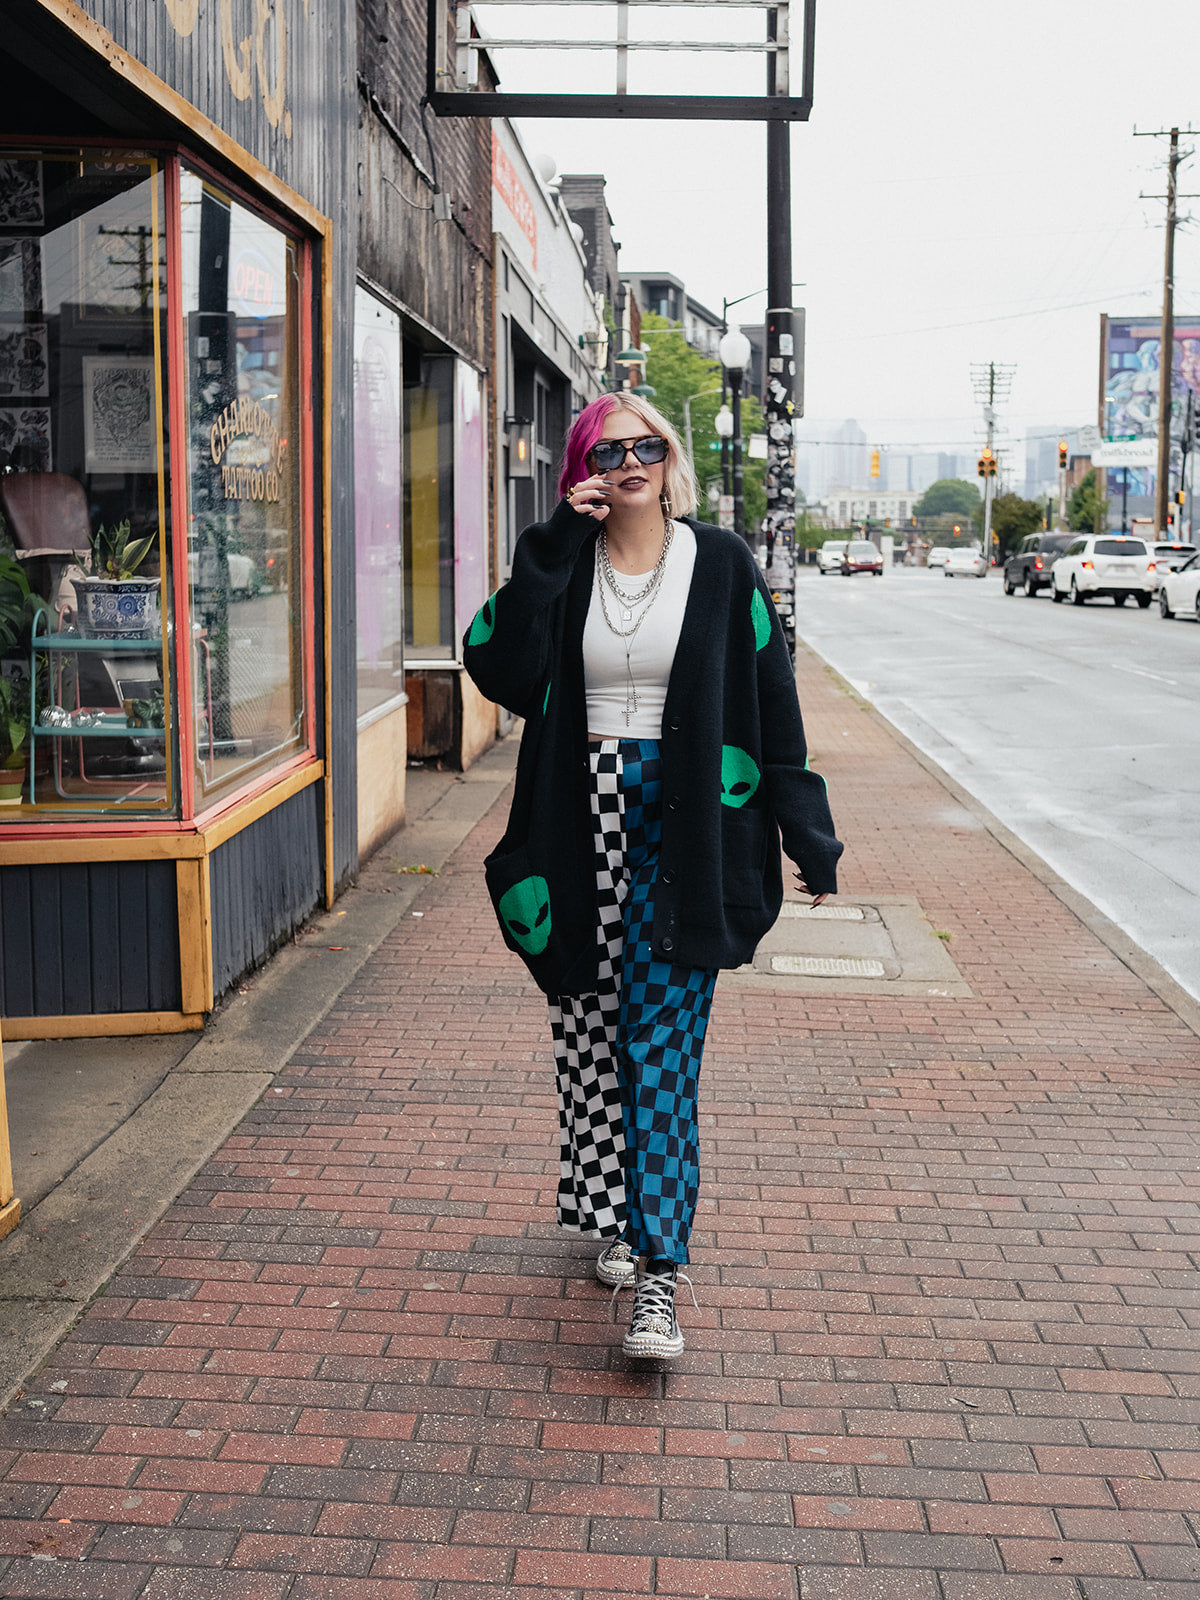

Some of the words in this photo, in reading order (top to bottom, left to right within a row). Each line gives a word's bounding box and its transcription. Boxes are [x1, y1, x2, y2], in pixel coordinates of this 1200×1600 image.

[234, 262, 274, 307] OPEN
[210, 397, 285, 475] CHARLOTTE
[222, 465, 264, 501] TATTOO
